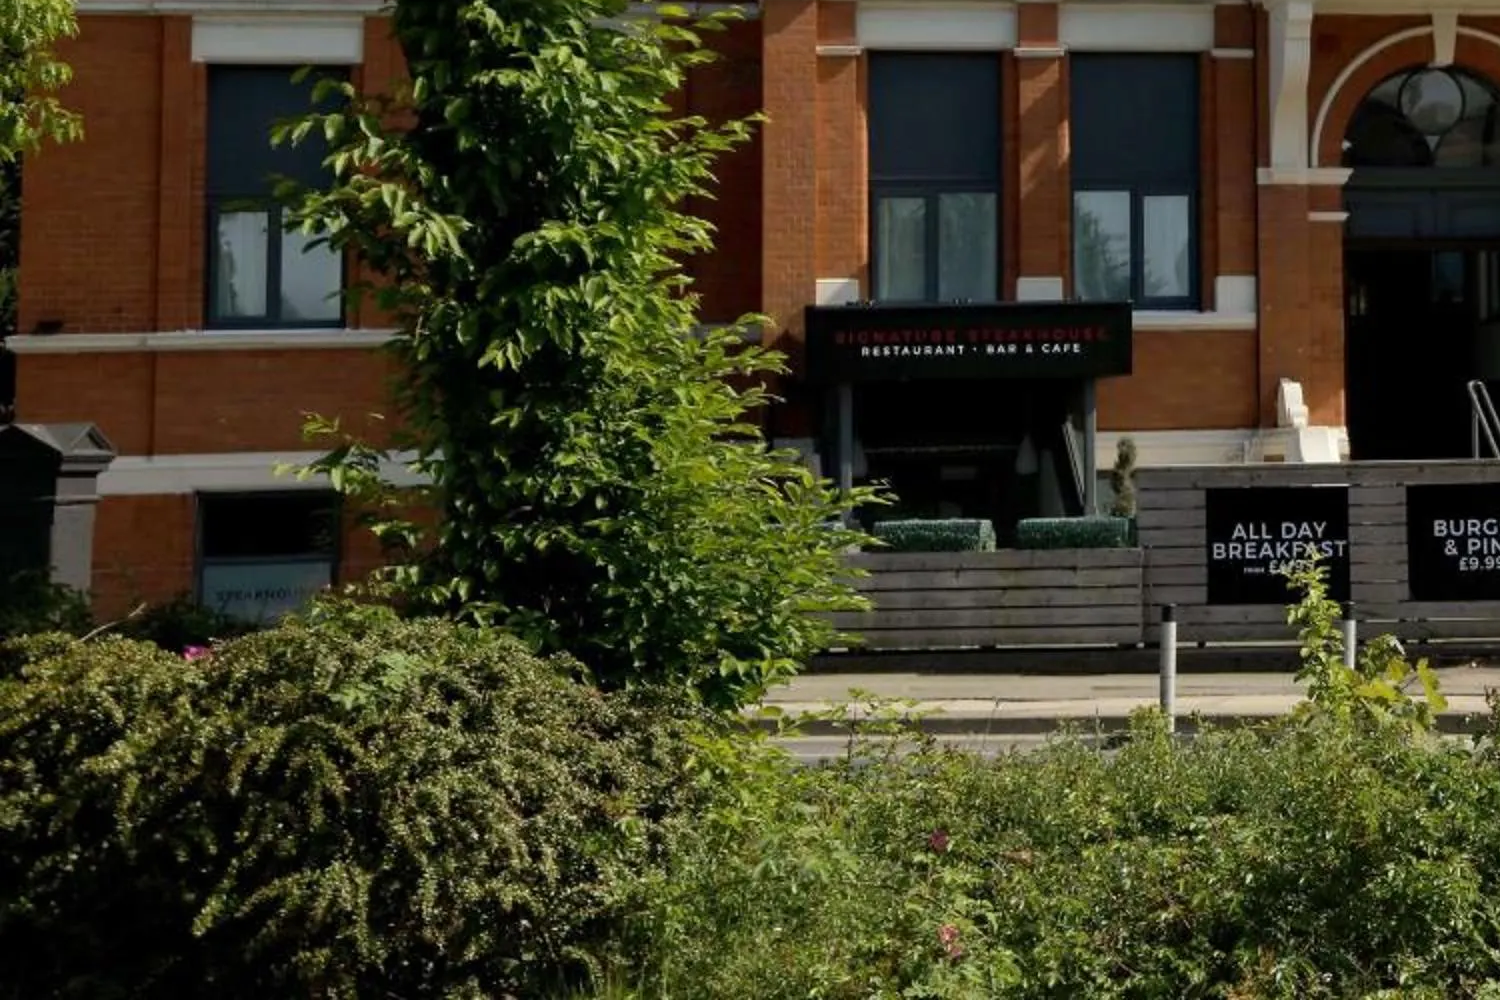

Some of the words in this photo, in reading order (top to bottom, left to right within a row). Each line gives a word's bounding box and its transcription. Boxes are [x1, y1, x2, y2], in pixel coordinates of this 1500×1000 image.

[835, 325, 956, 345] SIGNATURE
[966, 323, 1109, 343] STEAKHOUSE
[861, 344, 965, 358] RESTAURANT
[986, 343, 1015, 355] BAR
[1025, 343, 1034, 354] &
[1041, 342, 1082, 353] CAFE
[1231, 522, 1273, 541] ALL
[1281, 521, 1328, 539] DAY
[1212, 539, 1348, 560] BREAKFAST
[1444, 539, 1459, 556] &
